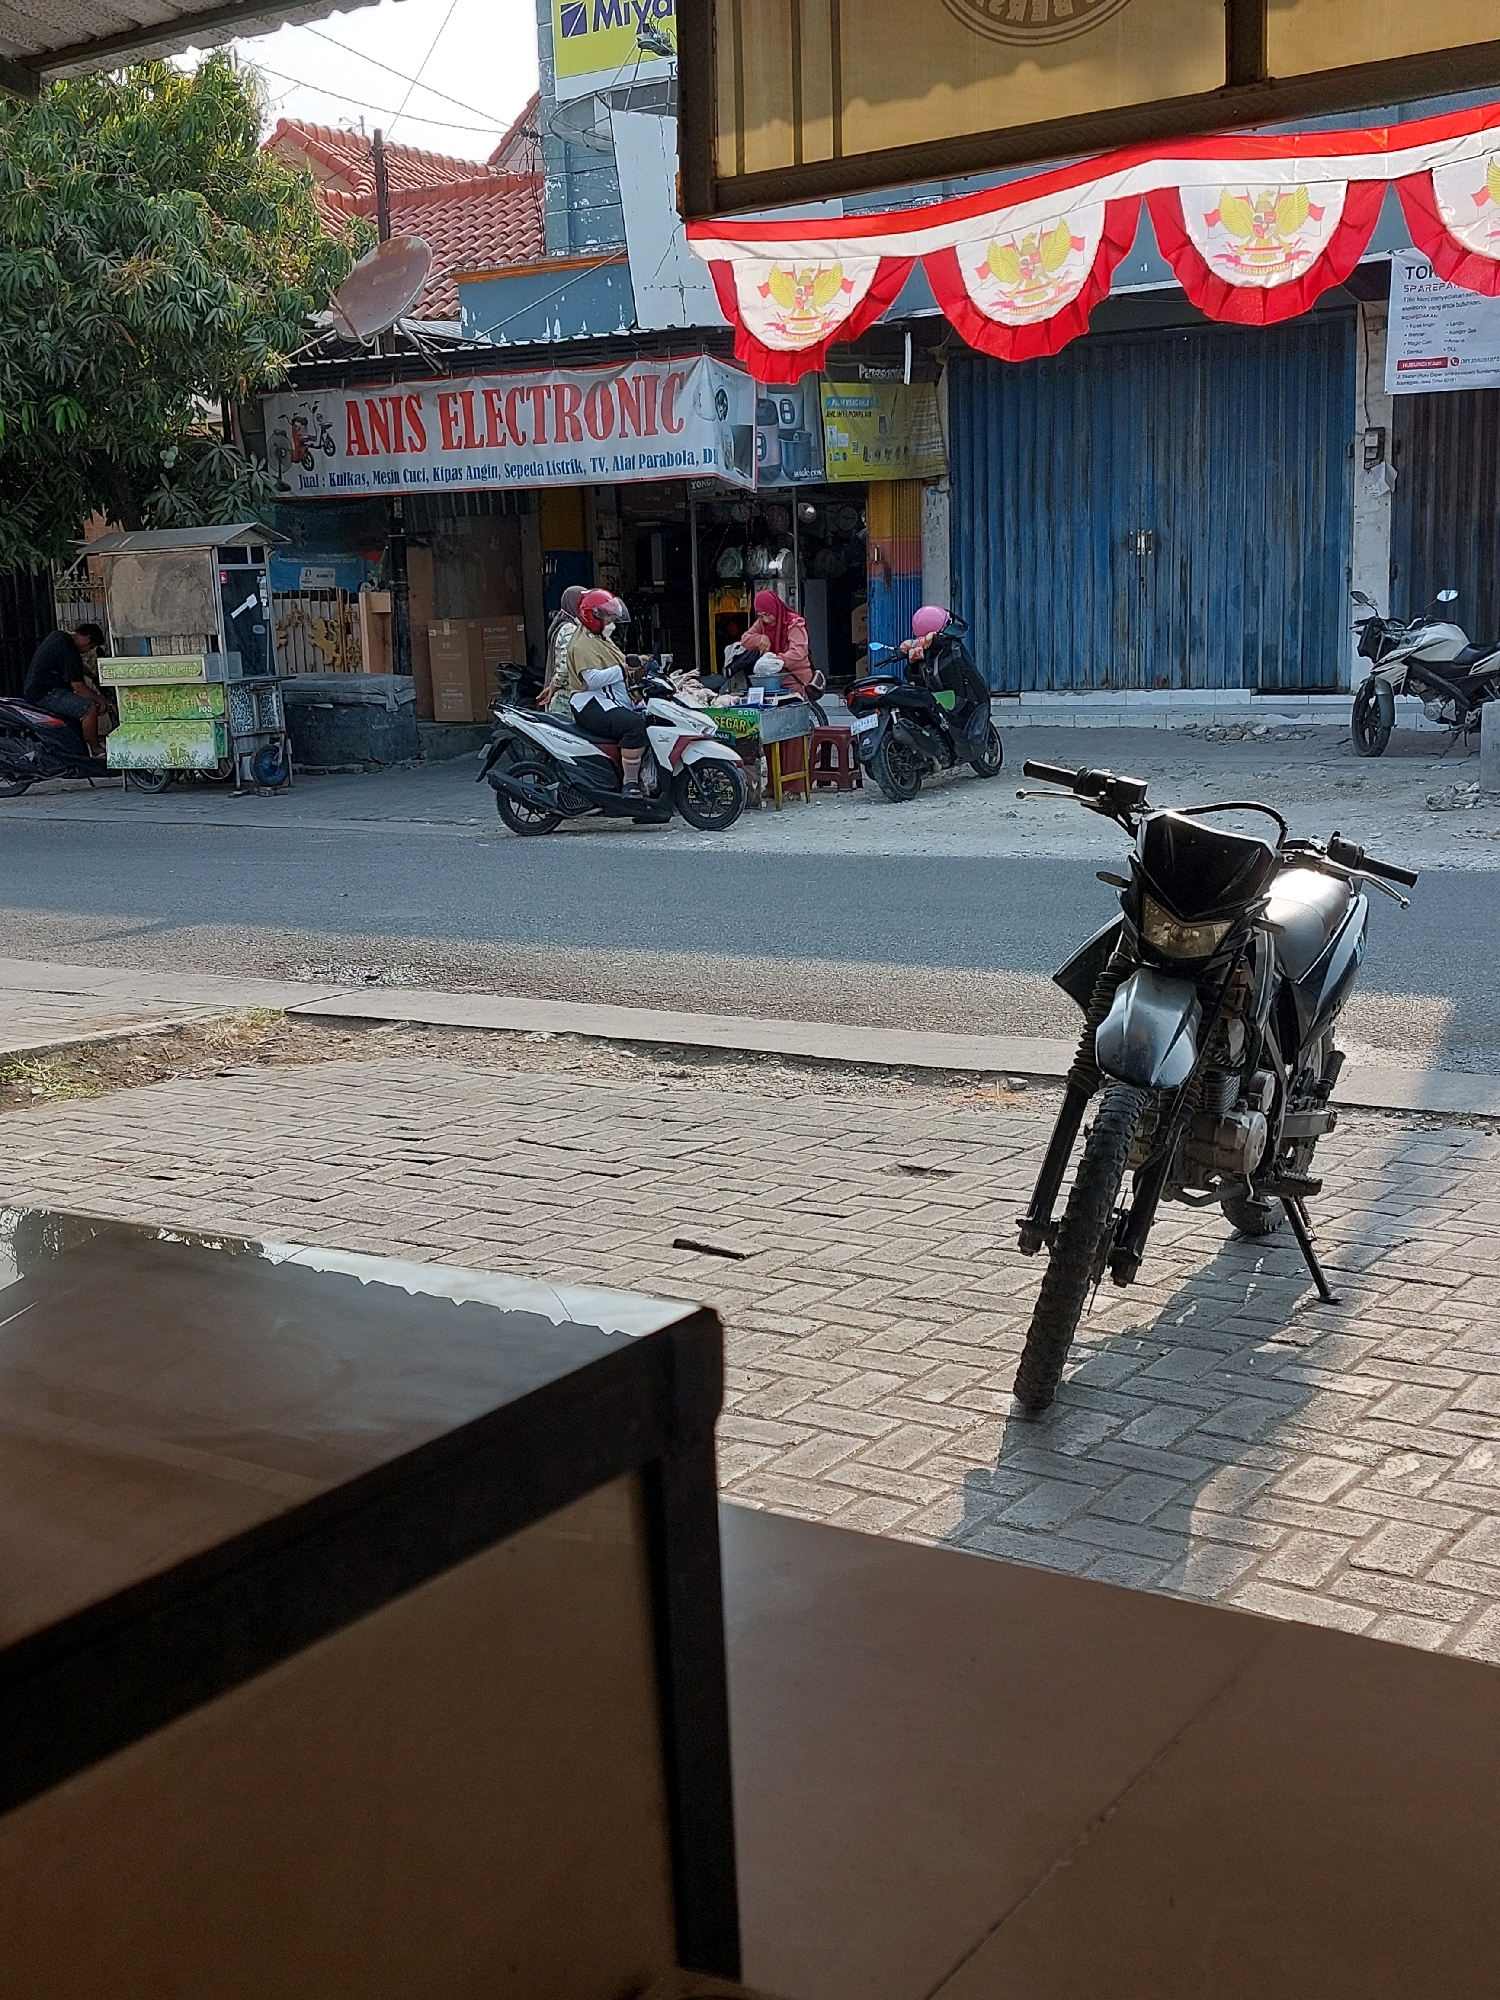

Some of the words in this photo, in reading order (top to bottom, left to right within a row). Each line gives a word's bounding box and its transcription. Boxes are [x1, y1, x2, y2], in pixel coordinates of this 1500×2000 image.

[592, 0, 677, 34] Miya
[858, 363, 905, 380] Panasonic
[345, 393, 427, 457] ANIS
[437, 371, 685, 451] ELECTRONIC
[298, 474, 319, 490] Jual
[328, 472, 370, 487] Kulkas,
[372, 469, 400, 486] Mesin
[403, 467, 430, 484] Cuci,
[433, 465, 463, 484] Kipas
[466, 463, 502, 482] Angin,
[504, 461, 544, 480] Sepeda
[546, 458, 587, 477] Listrik,
[589, 456, 609, 475] TV,
[612, 453, 636, 472] Alat
[638, 450, 700, 471] Parabola,
[690, 478, 715, 491] YONG
[713, 714, 747, 733] SEGAR
